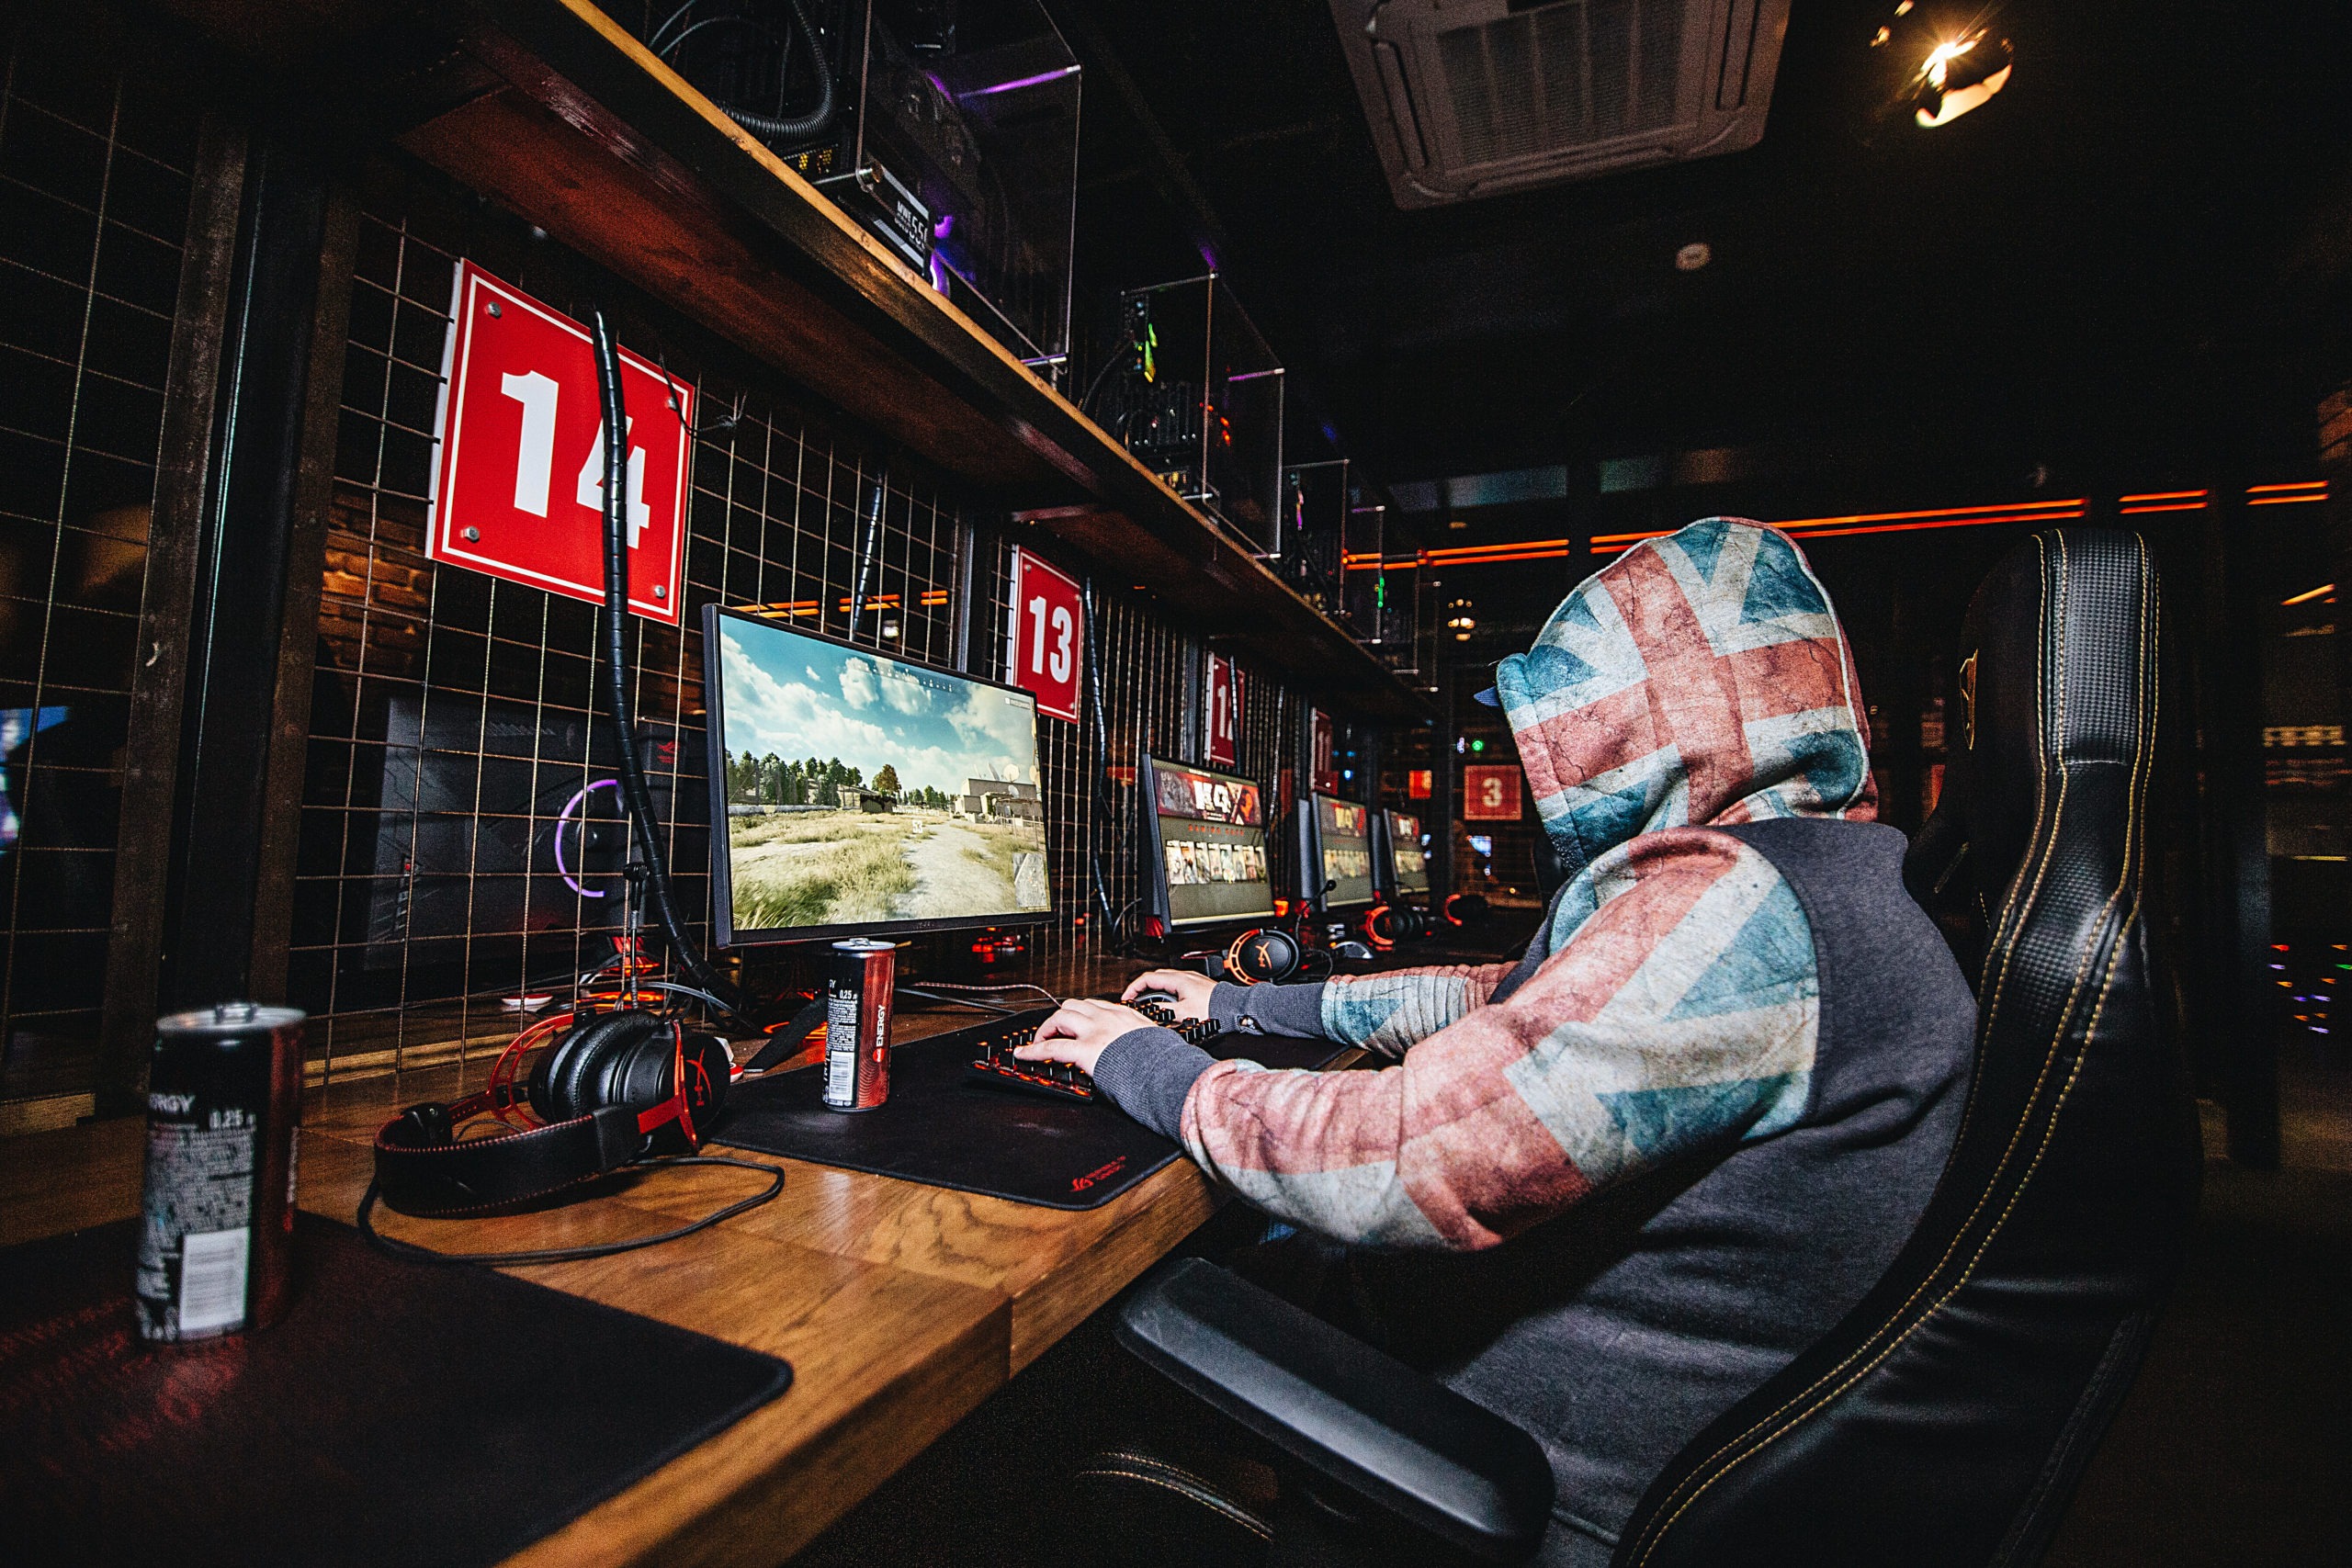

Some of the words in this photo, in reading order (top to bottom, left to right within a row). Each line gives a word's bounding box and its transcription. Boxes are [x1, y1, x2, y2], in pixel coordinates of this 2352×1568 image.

[501, 370, 650, 550] 14
[1029, 595, 1072, 683] 13
[1217, 684, 1234, 741] 1
[1482, 777, 1503, 807] 3
[876, 1004, 886, 1047] ENERGY
